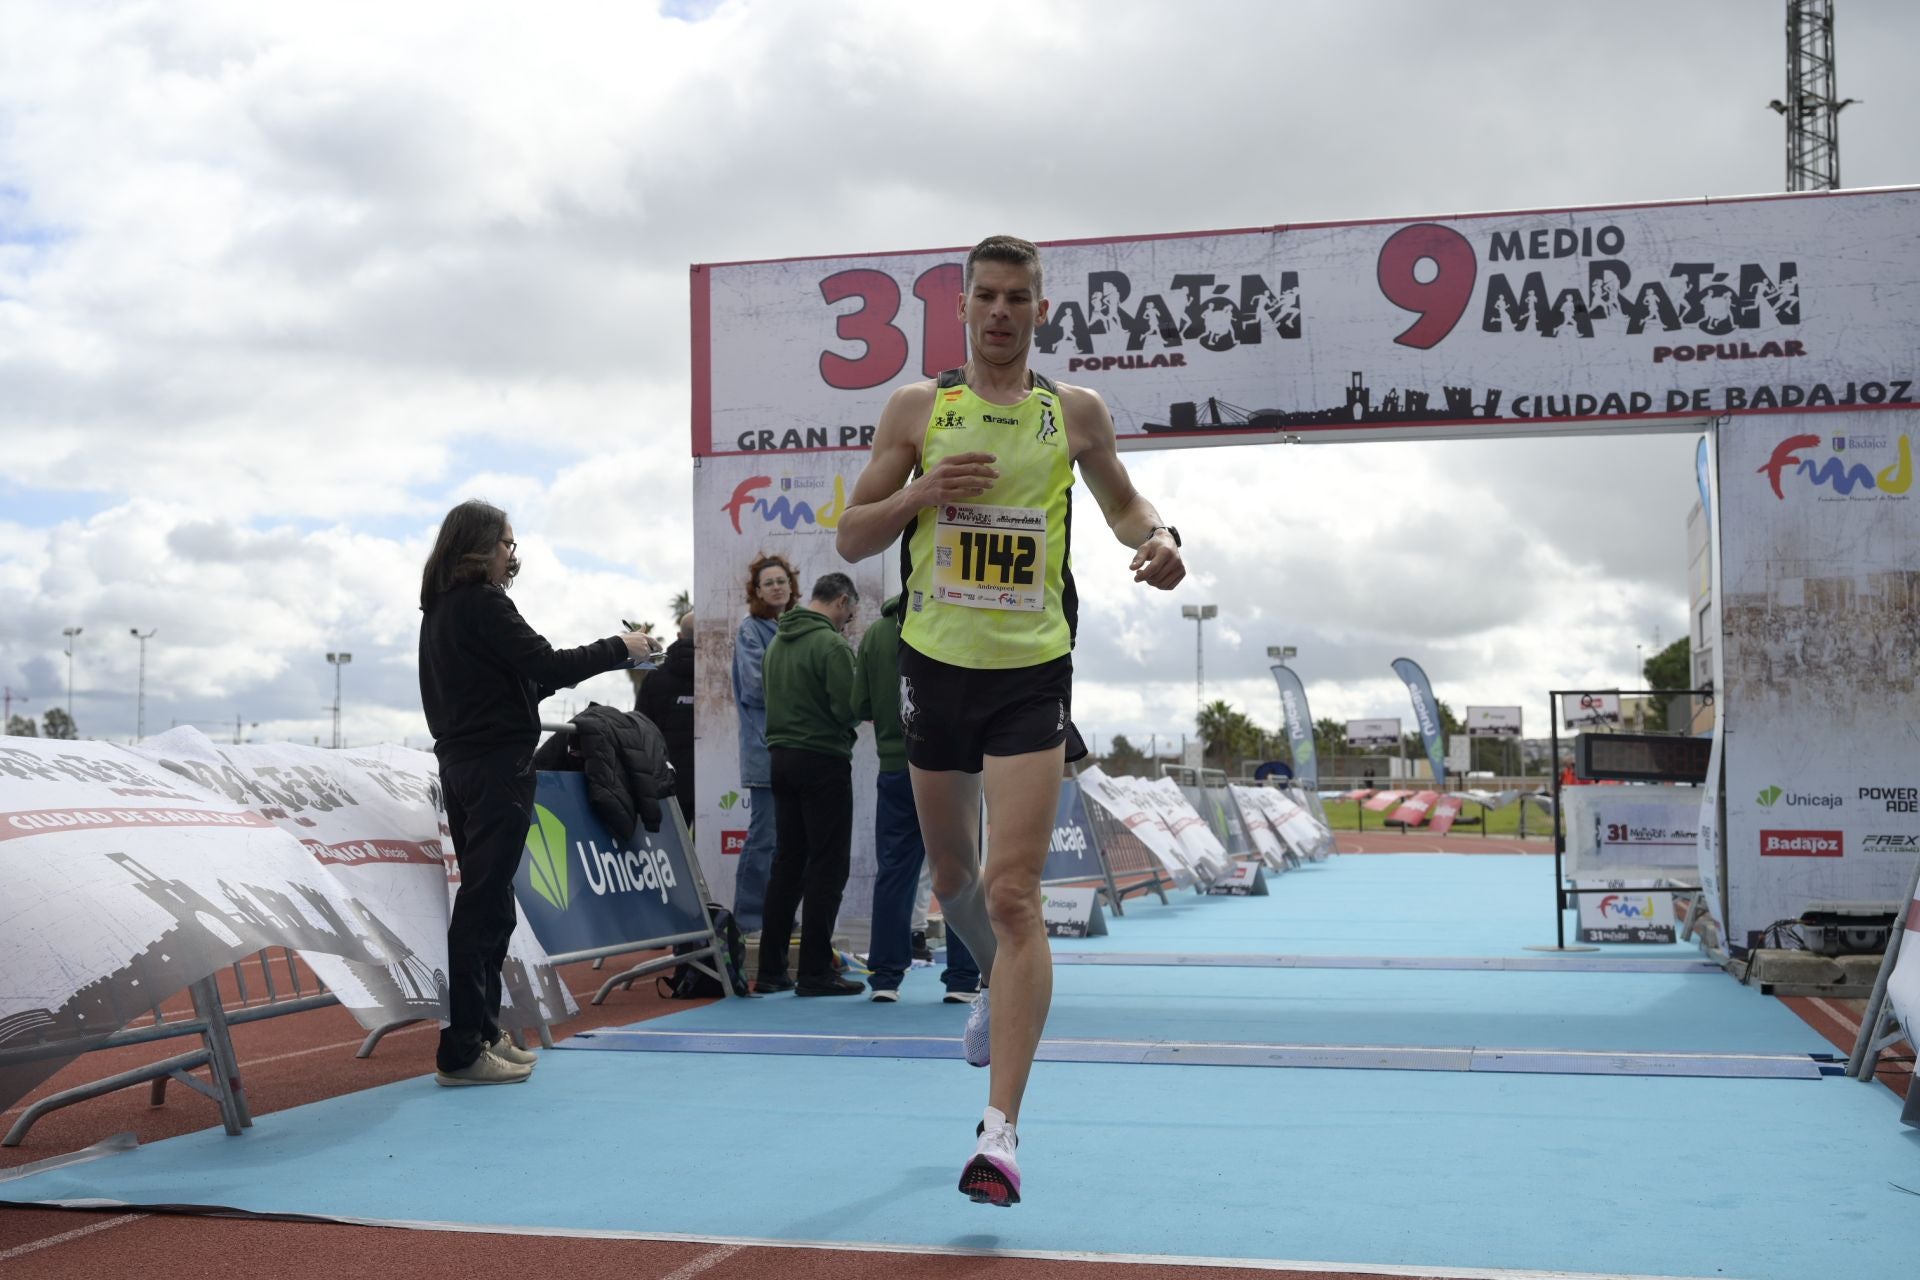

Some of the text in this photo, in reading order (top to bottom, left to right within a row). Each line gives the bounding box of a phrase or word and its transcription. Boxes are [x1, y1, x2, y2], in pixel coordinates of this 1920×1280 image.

[1488, 226, 1626, 261] MEDIO
[1377, 223, 1801, 350] 9 MARATÓN
[819, 263, 969, 390] 31
[1653, 340, 1808, 363] POPULAR
[1068, 353, 1188, 372] POPULAR
[1511, 381, 1913, 418] CIUDAD DE BADAJOZ
[737, 426, 828, 451] GRAN
[945, 506, 957, 521] 9
[960, 531, 1036, 584] 1142
[1786, 793, 1843, 809] Unicaja
[1859, 788, 1918, 800] POWER
[1886, 801, 1919, 813] ADE
[8, 811, 113, 830] CIUDAD
[117, 810, 152, 823] DE
[149, 811, 256, 826] BADAJOZ
[1048, 818, 1087, 860] nicaja
[1607, 824, 1628, 841] 31
[1862, 835, 1919, 846] FAEX
[1766, 836, 1839, 854] Badajoz
[576, 837, 677, 904] Unicaja
[1590, 930, 1603, 941] 31
